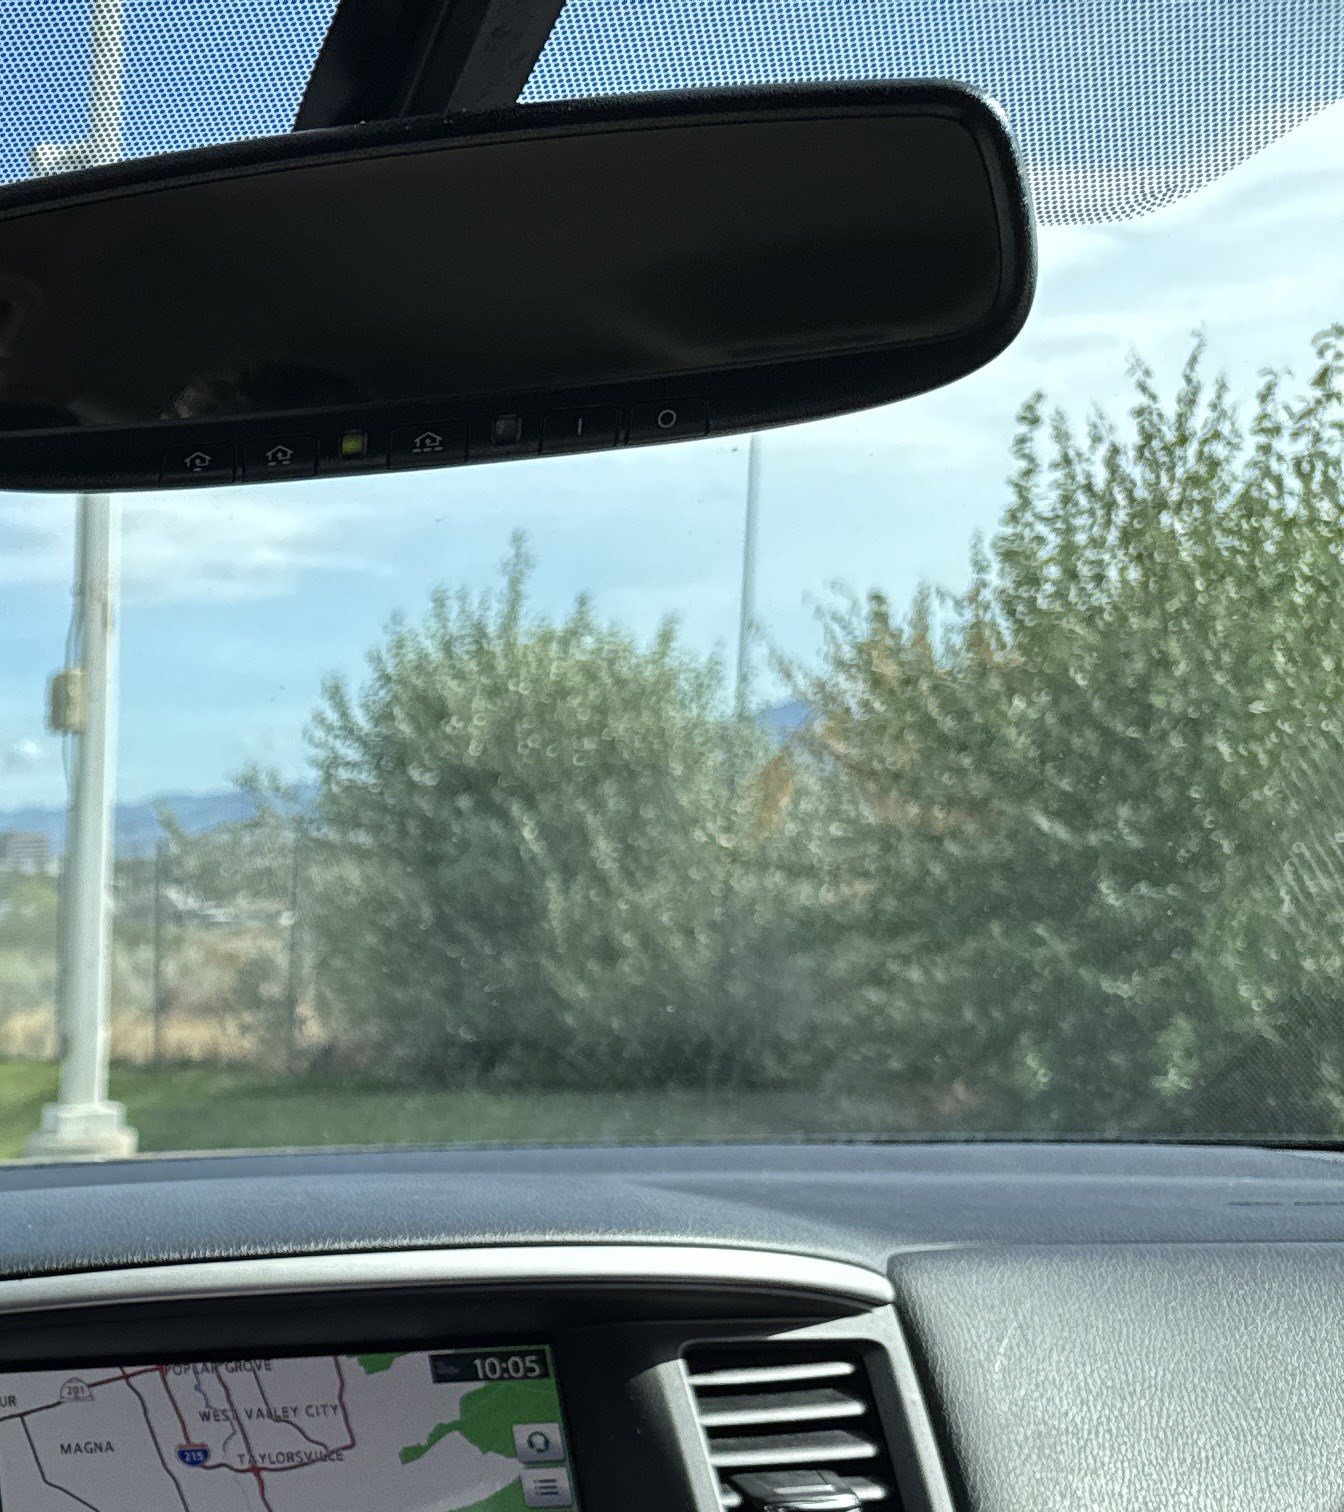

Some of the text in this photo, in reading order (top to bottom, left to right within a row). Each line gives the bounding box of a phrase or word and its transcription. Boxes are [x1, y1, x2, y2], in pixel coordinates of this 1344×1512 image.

[225, 1359, 273, 1374] GROVE
[473, 1354, 541, 1381] 10:05
[198, 1403, 339, 1423] WEST VALLEY CITY
[59, 1440, 116, 1456] MAGNA
[183, 1450, 205, 1462] 215
[237, 1449, 345, 1466] TAYLORSVILLE
